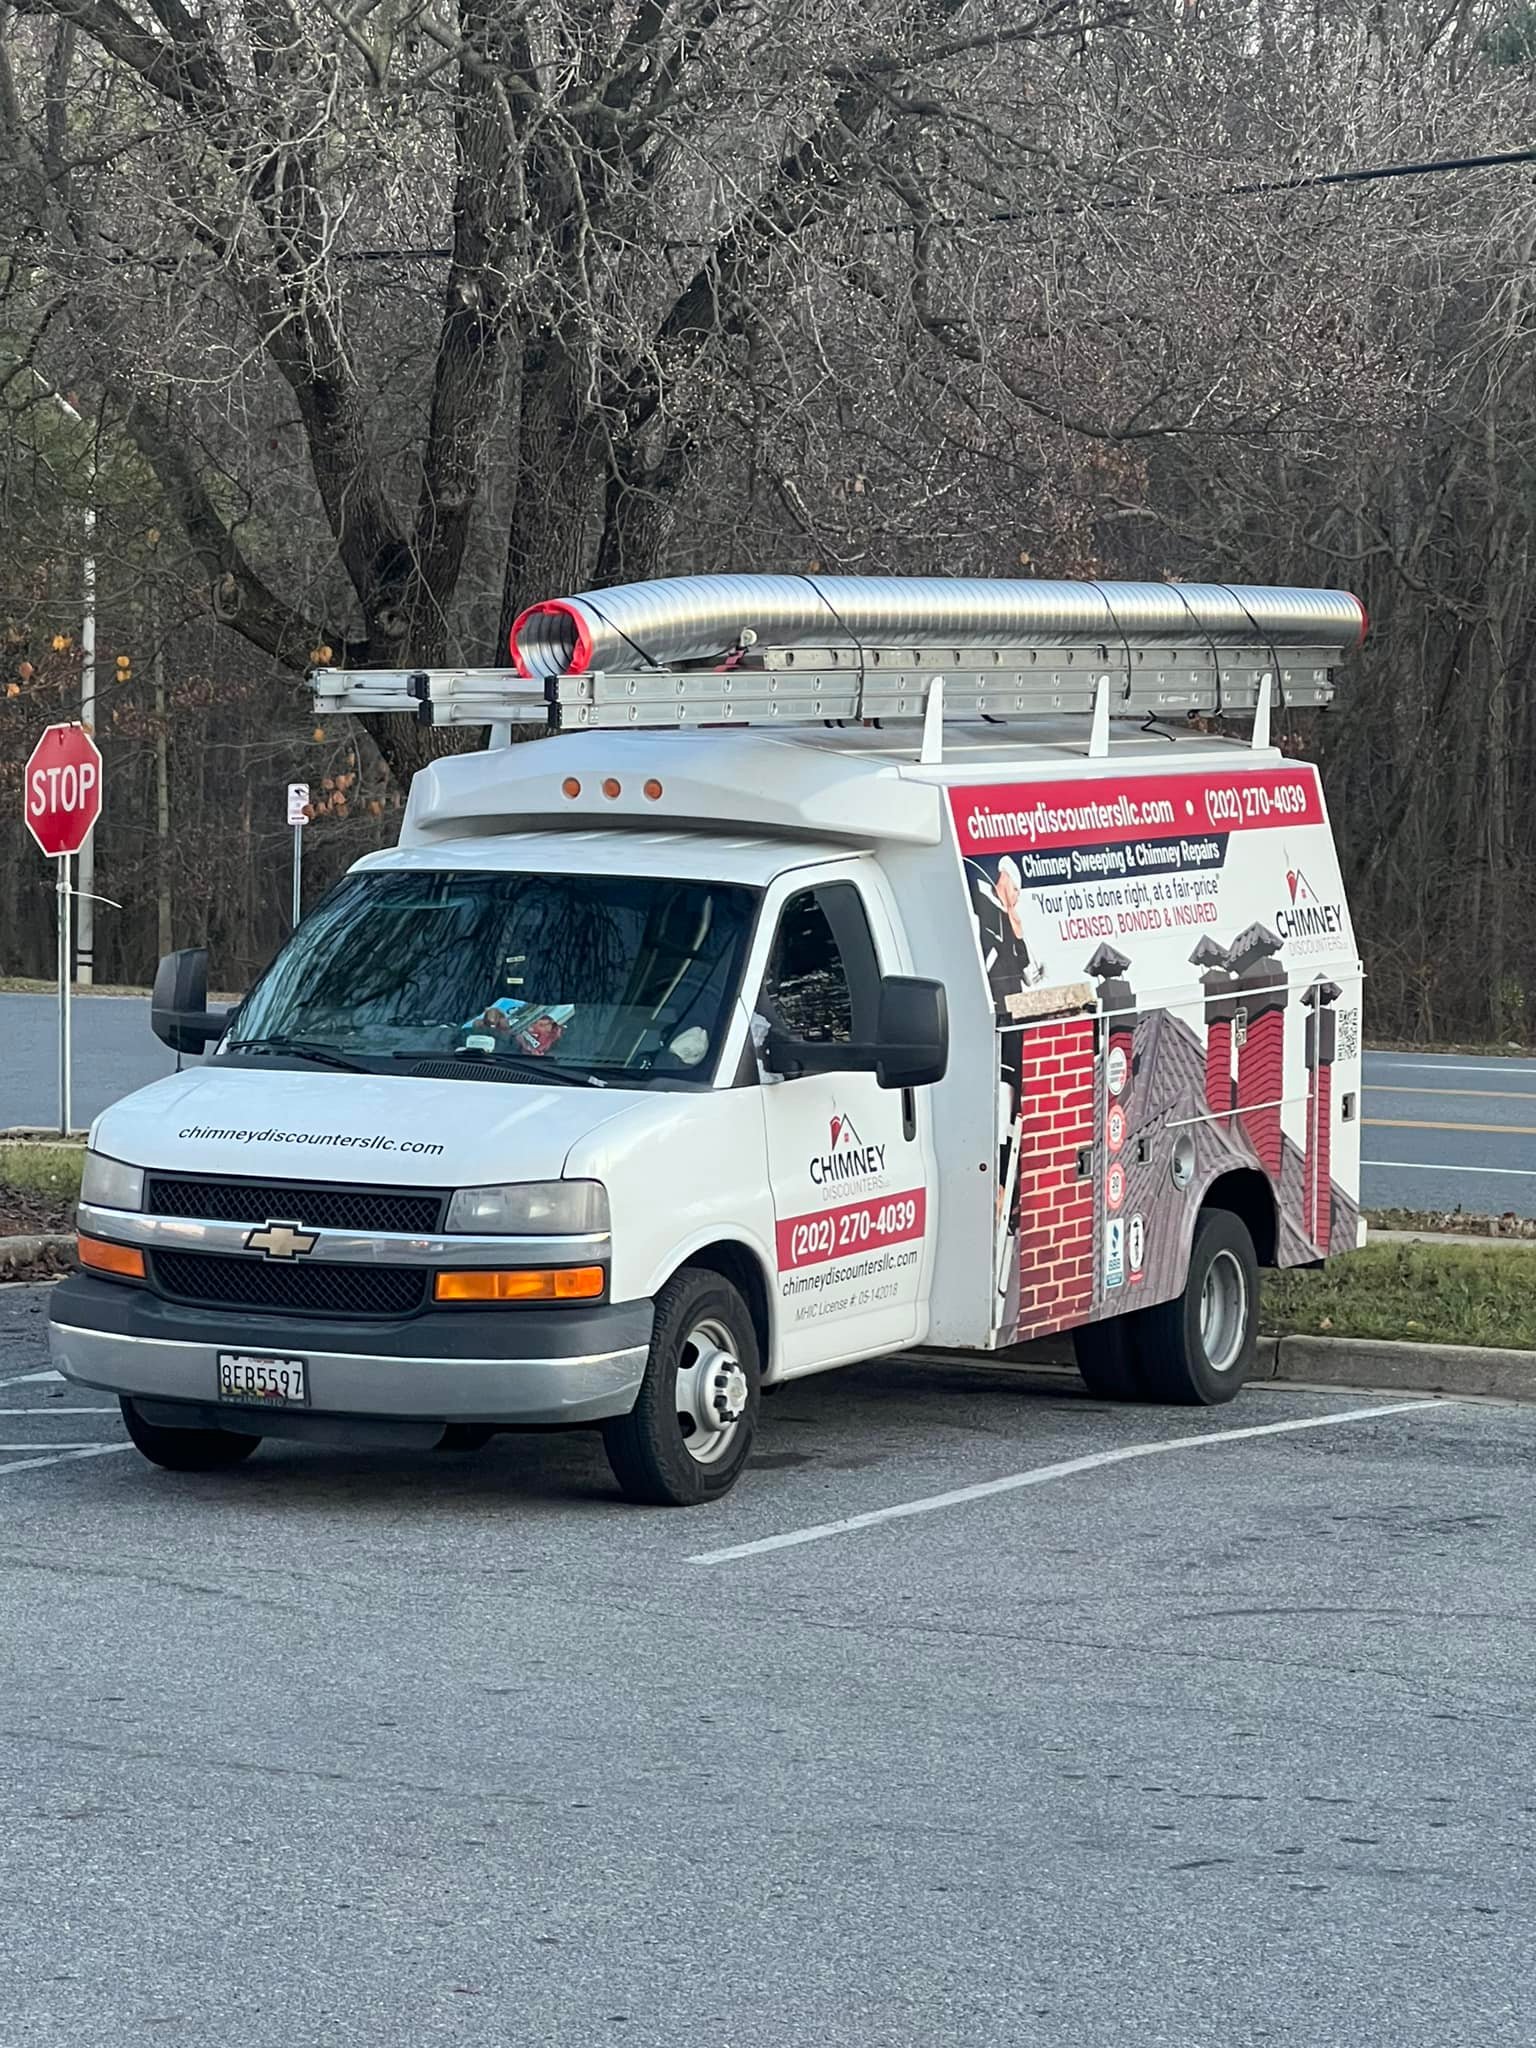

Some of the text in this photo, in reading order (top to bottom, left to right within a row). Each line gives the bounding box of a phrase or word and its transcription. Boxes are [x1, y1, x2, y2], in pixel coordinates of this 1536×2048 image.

[31, 762, 96, 816] STOP
[967, 784, 1307, 843] chimneydiscountersllc.com (202) 270-4039
[1021, 837, 1220, 879] Chimney Sweeping & Chimney Repairs
[1063, 891, 1084, 917] job
[1084, 890, 1096, 909] is
[1096, 882, 1124, 907] done
[1124, 878, 1153, 906] right,
[1152, 881, 1165, 900] at
[1165, 883, 1173, 898] a
[1058, 902, 1218, 941] LICENSED, BONDED & INSURED
[1276, 904, 1342, 939] CHIMNEY
[178, 1126, 445, 1155] chimneydiscountersllc.com
[810, 1144, 886, 1184] CHIMNEY
[822, 1174, 884, 1202] DISCOUNTERS
[791, 1199, 916, 1264] (202) 270-4039
[782, 1250, 918, 1297] chimneydiscountersllc.com
[222, 1364, 302, 1395] 8EB5597
